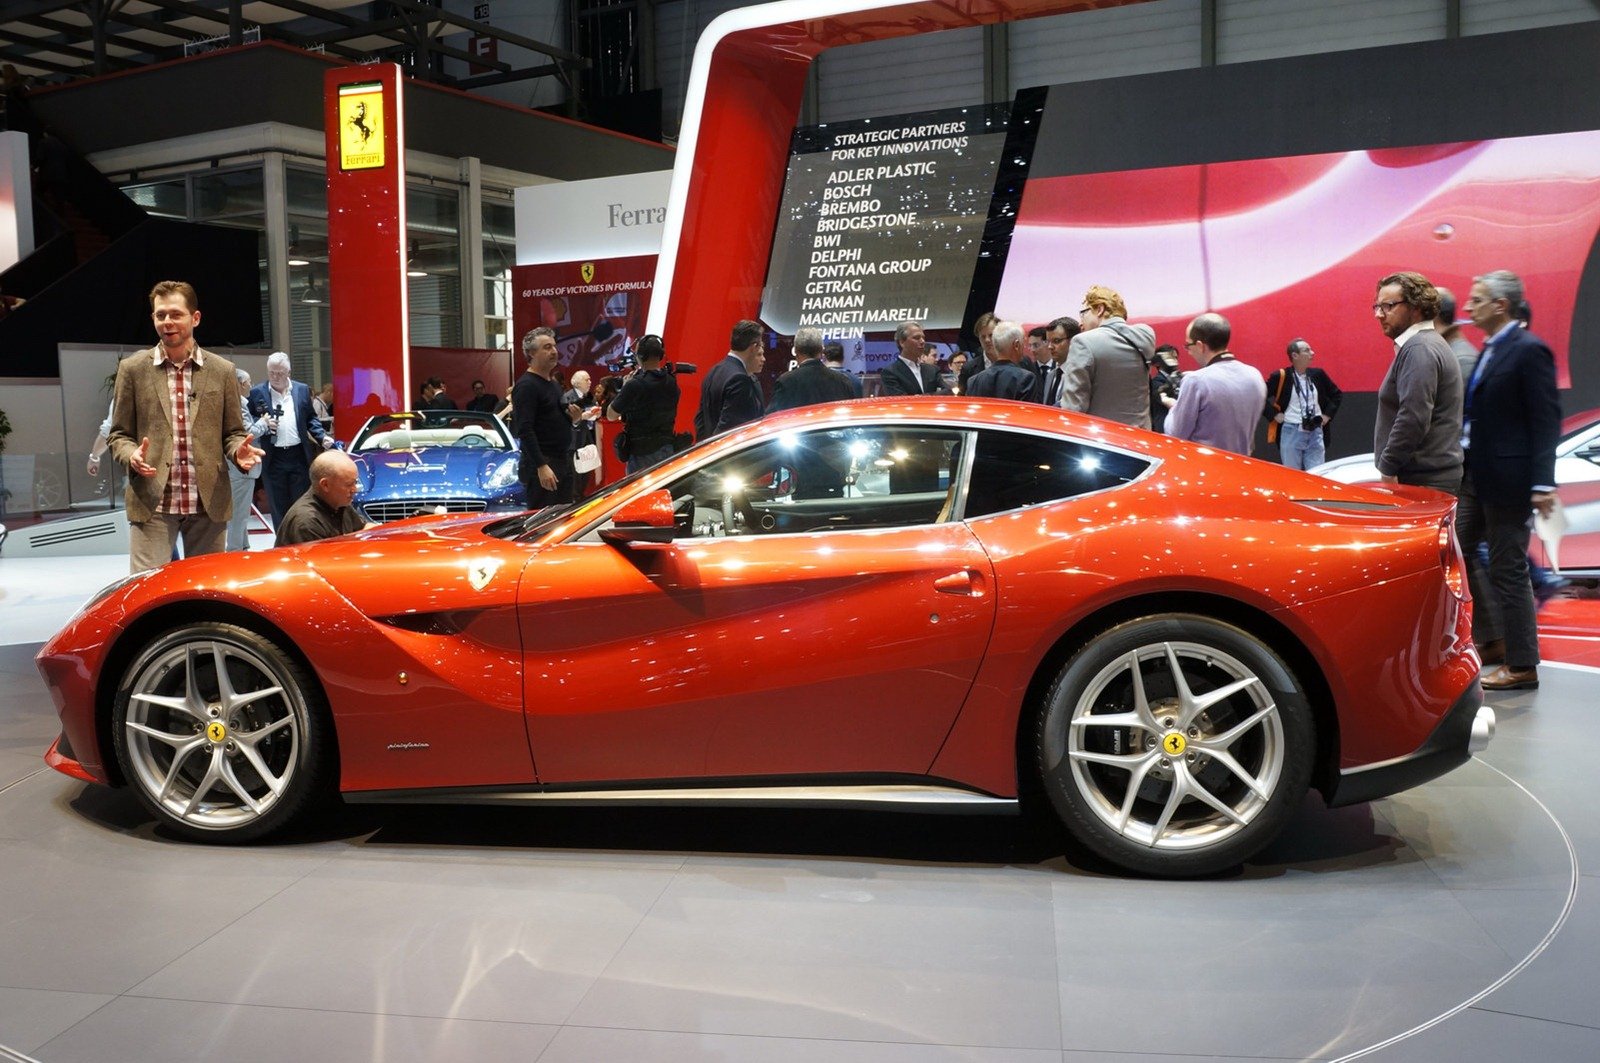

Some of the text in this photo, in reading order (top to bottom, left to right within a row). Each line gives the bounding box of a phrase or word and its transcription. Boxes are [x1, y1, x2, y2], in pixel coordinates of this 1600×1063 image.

[834, 121, 967, 147] STRATEGIC PARTNERS
[830, 136, 969, 162] FOR KEY INNOVATIONS
[345, 153, 380, 166] Ferrari
[826, 160, 937, 185] ADLER PLASTIC
[822, 183, 873, 201] BOSCH
[607, 203, 668, 229] Ferra
[819, 199, 882, 217] BREMBO
[815, 212, 918, 234] BRIDGESTONE
[812, 233, 842, 249] BWI
[810, 248, 862, 265] DELPHI
[808, 258, 933, 280] FONTANA GROUP
[522, 281, 653, 298] 60 YEARS OF VICTORIES IN FORMULA
[805, 279, 862, 296] GETRAG
[801, 294, 865, 311] HARMAN
[798, 307, 929, 327] MAGNETI MARELLI
[820, 326, 864, 340] HELIN
[865, 353, 894, 362] TOYOT
